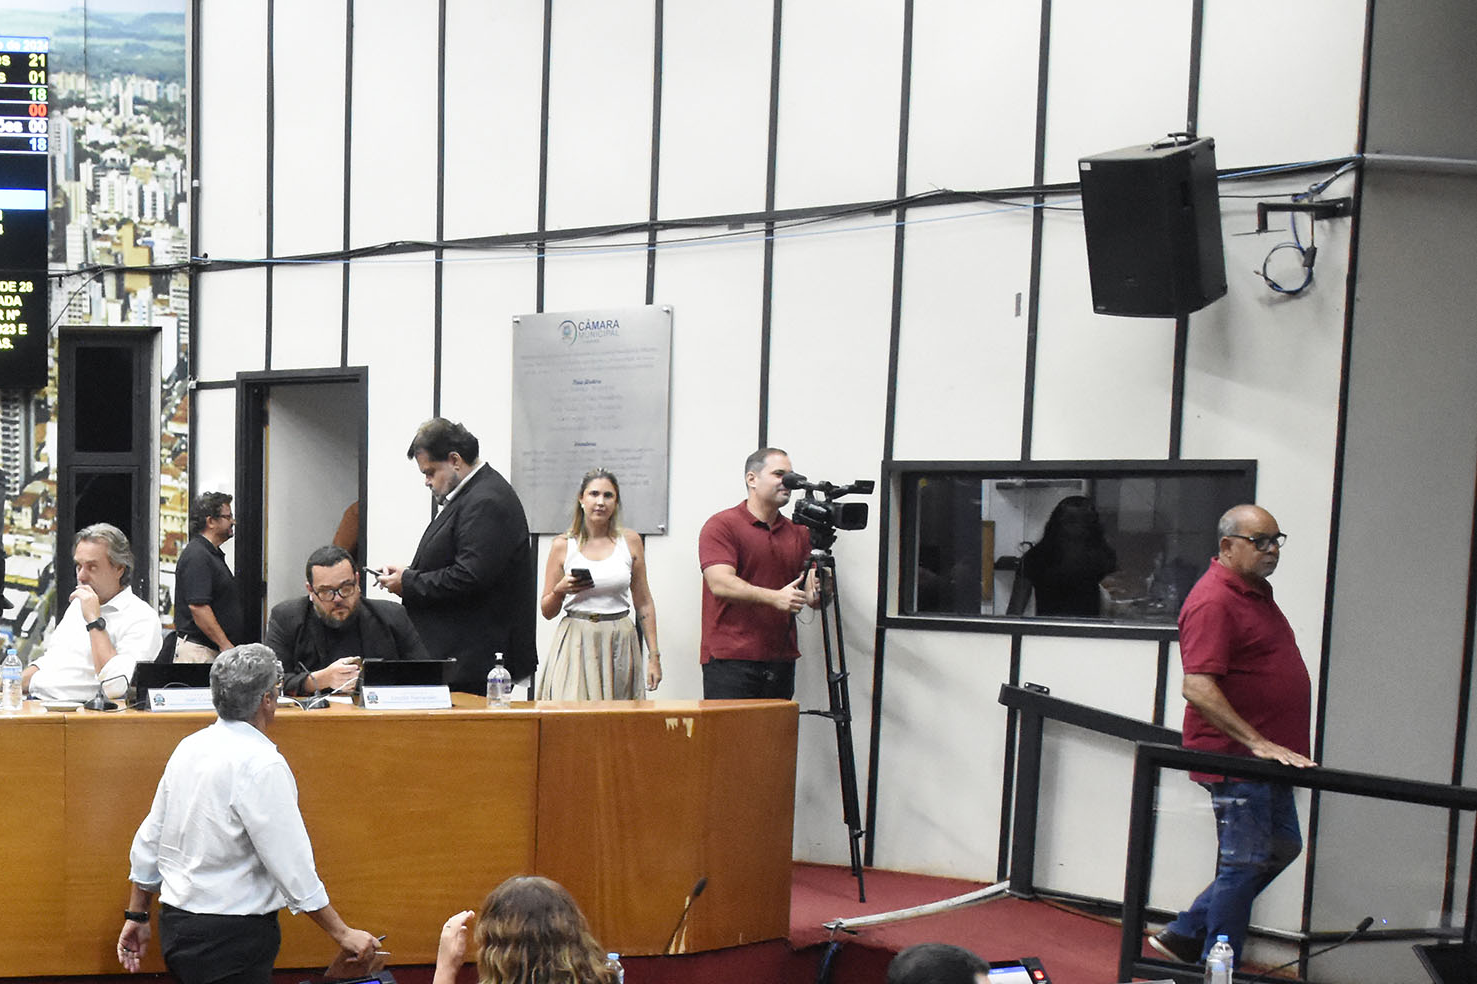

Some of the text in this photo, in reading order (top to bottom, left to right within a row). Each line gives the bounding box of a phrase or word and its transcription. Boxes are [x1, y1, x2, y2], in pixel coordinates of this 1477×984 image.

[29, 54, 45, 67] 21
[29, 70, 45, 84] 01
[30, 88, 47, 101] 18
[29, 104, 47, 116] 00
[29, 119, 47, 133] 00
[30, 138, 46, 151] 18
[0, 282, 16, 292] DE
[19, 324, 27, 334] E
